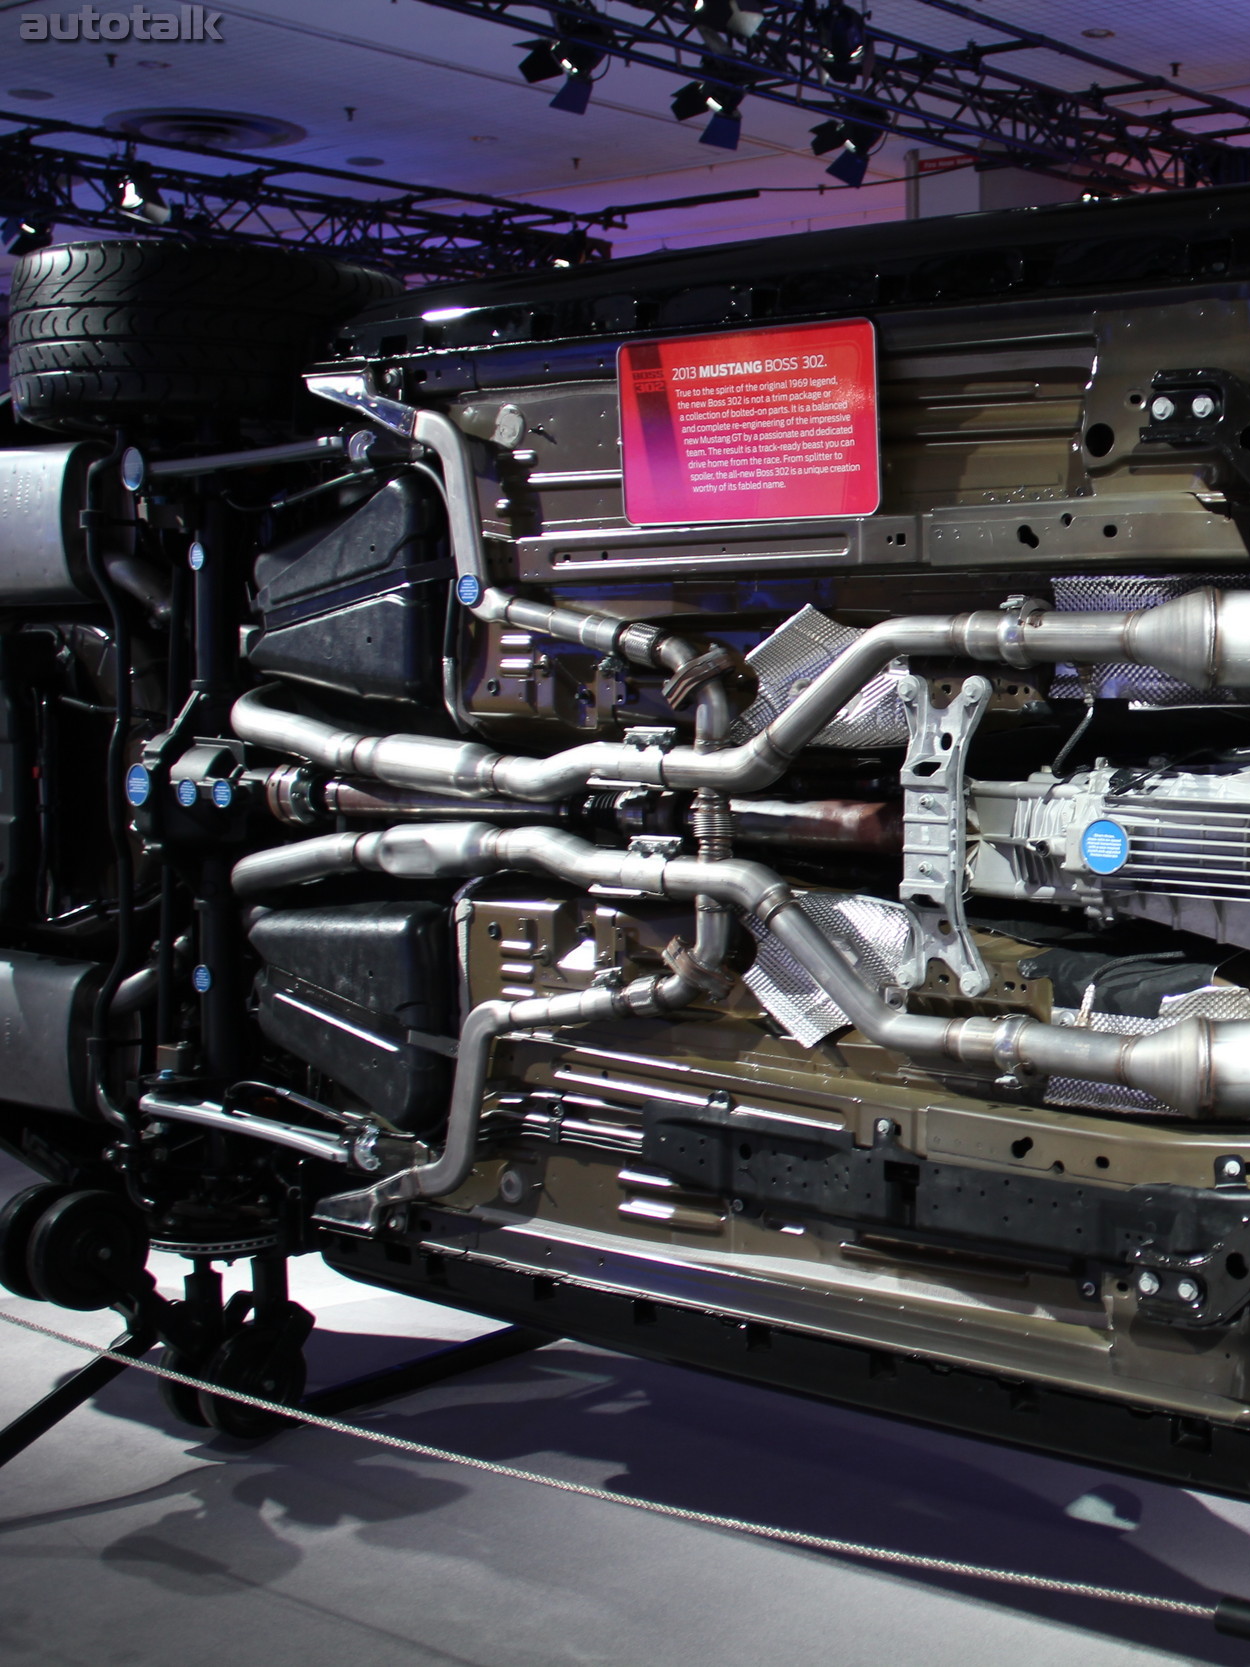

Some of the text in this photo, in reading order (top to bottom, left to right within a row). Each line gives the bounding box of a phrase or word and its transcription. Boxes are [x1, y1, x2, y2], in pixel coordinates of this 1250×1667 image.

[672, 354, 827, 381] 2013 MUSTANG BOSS 302.
[675, 389, 691, 397] True
[693, 388, 701, 396] to
[702, 386, 715, 395] the
[716, 384, 735, 396] spirit
[736, 383, 744, 393] of
[745, 382, 758, 391] the
[759, 380, 788, 391] original
[789, 378, 808, 388] 1969
[677, 390, 832, 410] the new Boss 302 is not a trim package or
[679, 400, 848, 422] a collection of bolted-on parts. It is a balanced
[682, 413, 851, 434] and complete re-engineering of the impressive
[684, 437, 699, 445] new
[700, 434, 731, 444] Mustang
[732, 433, 742, 442] GT
[743, 433, 752, 442] by
[759, 430, 799, 441] passionate
[800, 428, 815, 437] and
[815, 425, 853, 435] dedicated
[686, 448, 707, 457] team.
[708, 446, 722, 455] The
[723, 445, 744, 455] result
[745, 445, 751, 453] is
[759, 441, 801, 453] track-ready
[802, 440, 824, 450] beast
[825, 439, 839, 449] you
[840, 438, 855, 447] can
[688, 452, 843, 469] drive home from the race. From splitter to
[716, 471, 727, 479] the
[728, 470, 755, 478] all-new
[756, 468, 774, 477] Boss
[774, 466, 790, 476] 302
[790, 467, 796, 475] is
[797, 467, 802, 475] a
[804, 465, 829, 475] unique
[830, 463, 860, 472] creation
[693, 480, 786, 493] worthy of its fabled name.
